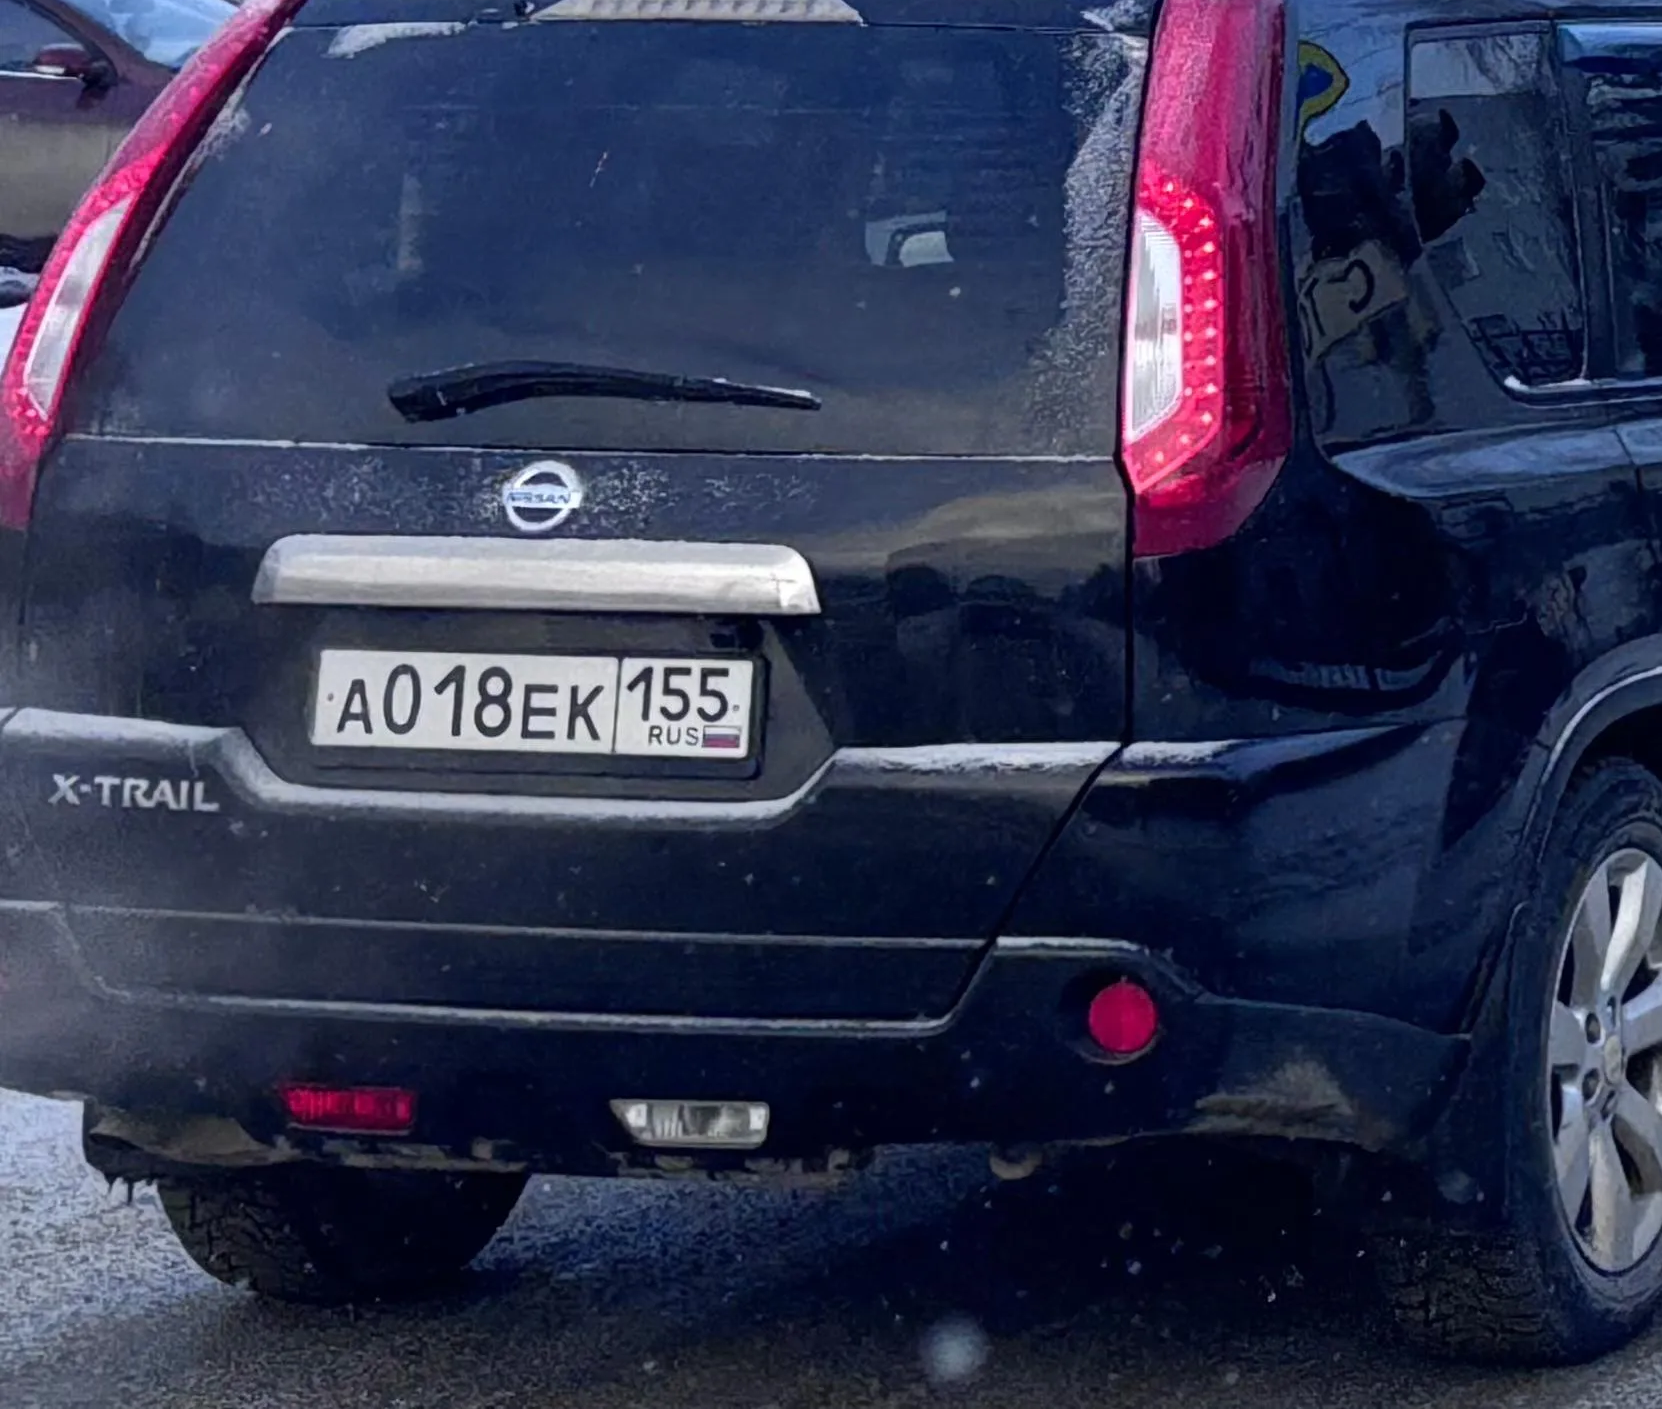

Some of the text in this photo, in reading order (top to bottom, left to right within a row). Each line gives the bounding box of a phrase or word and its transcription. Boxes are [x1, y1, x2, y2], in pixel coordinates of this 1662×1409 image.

[335, 662, 731, 742] А018ЕК 155
[646, 725, 701, 748] RUS
[47, 773, 221, 814] X-TRAIL
